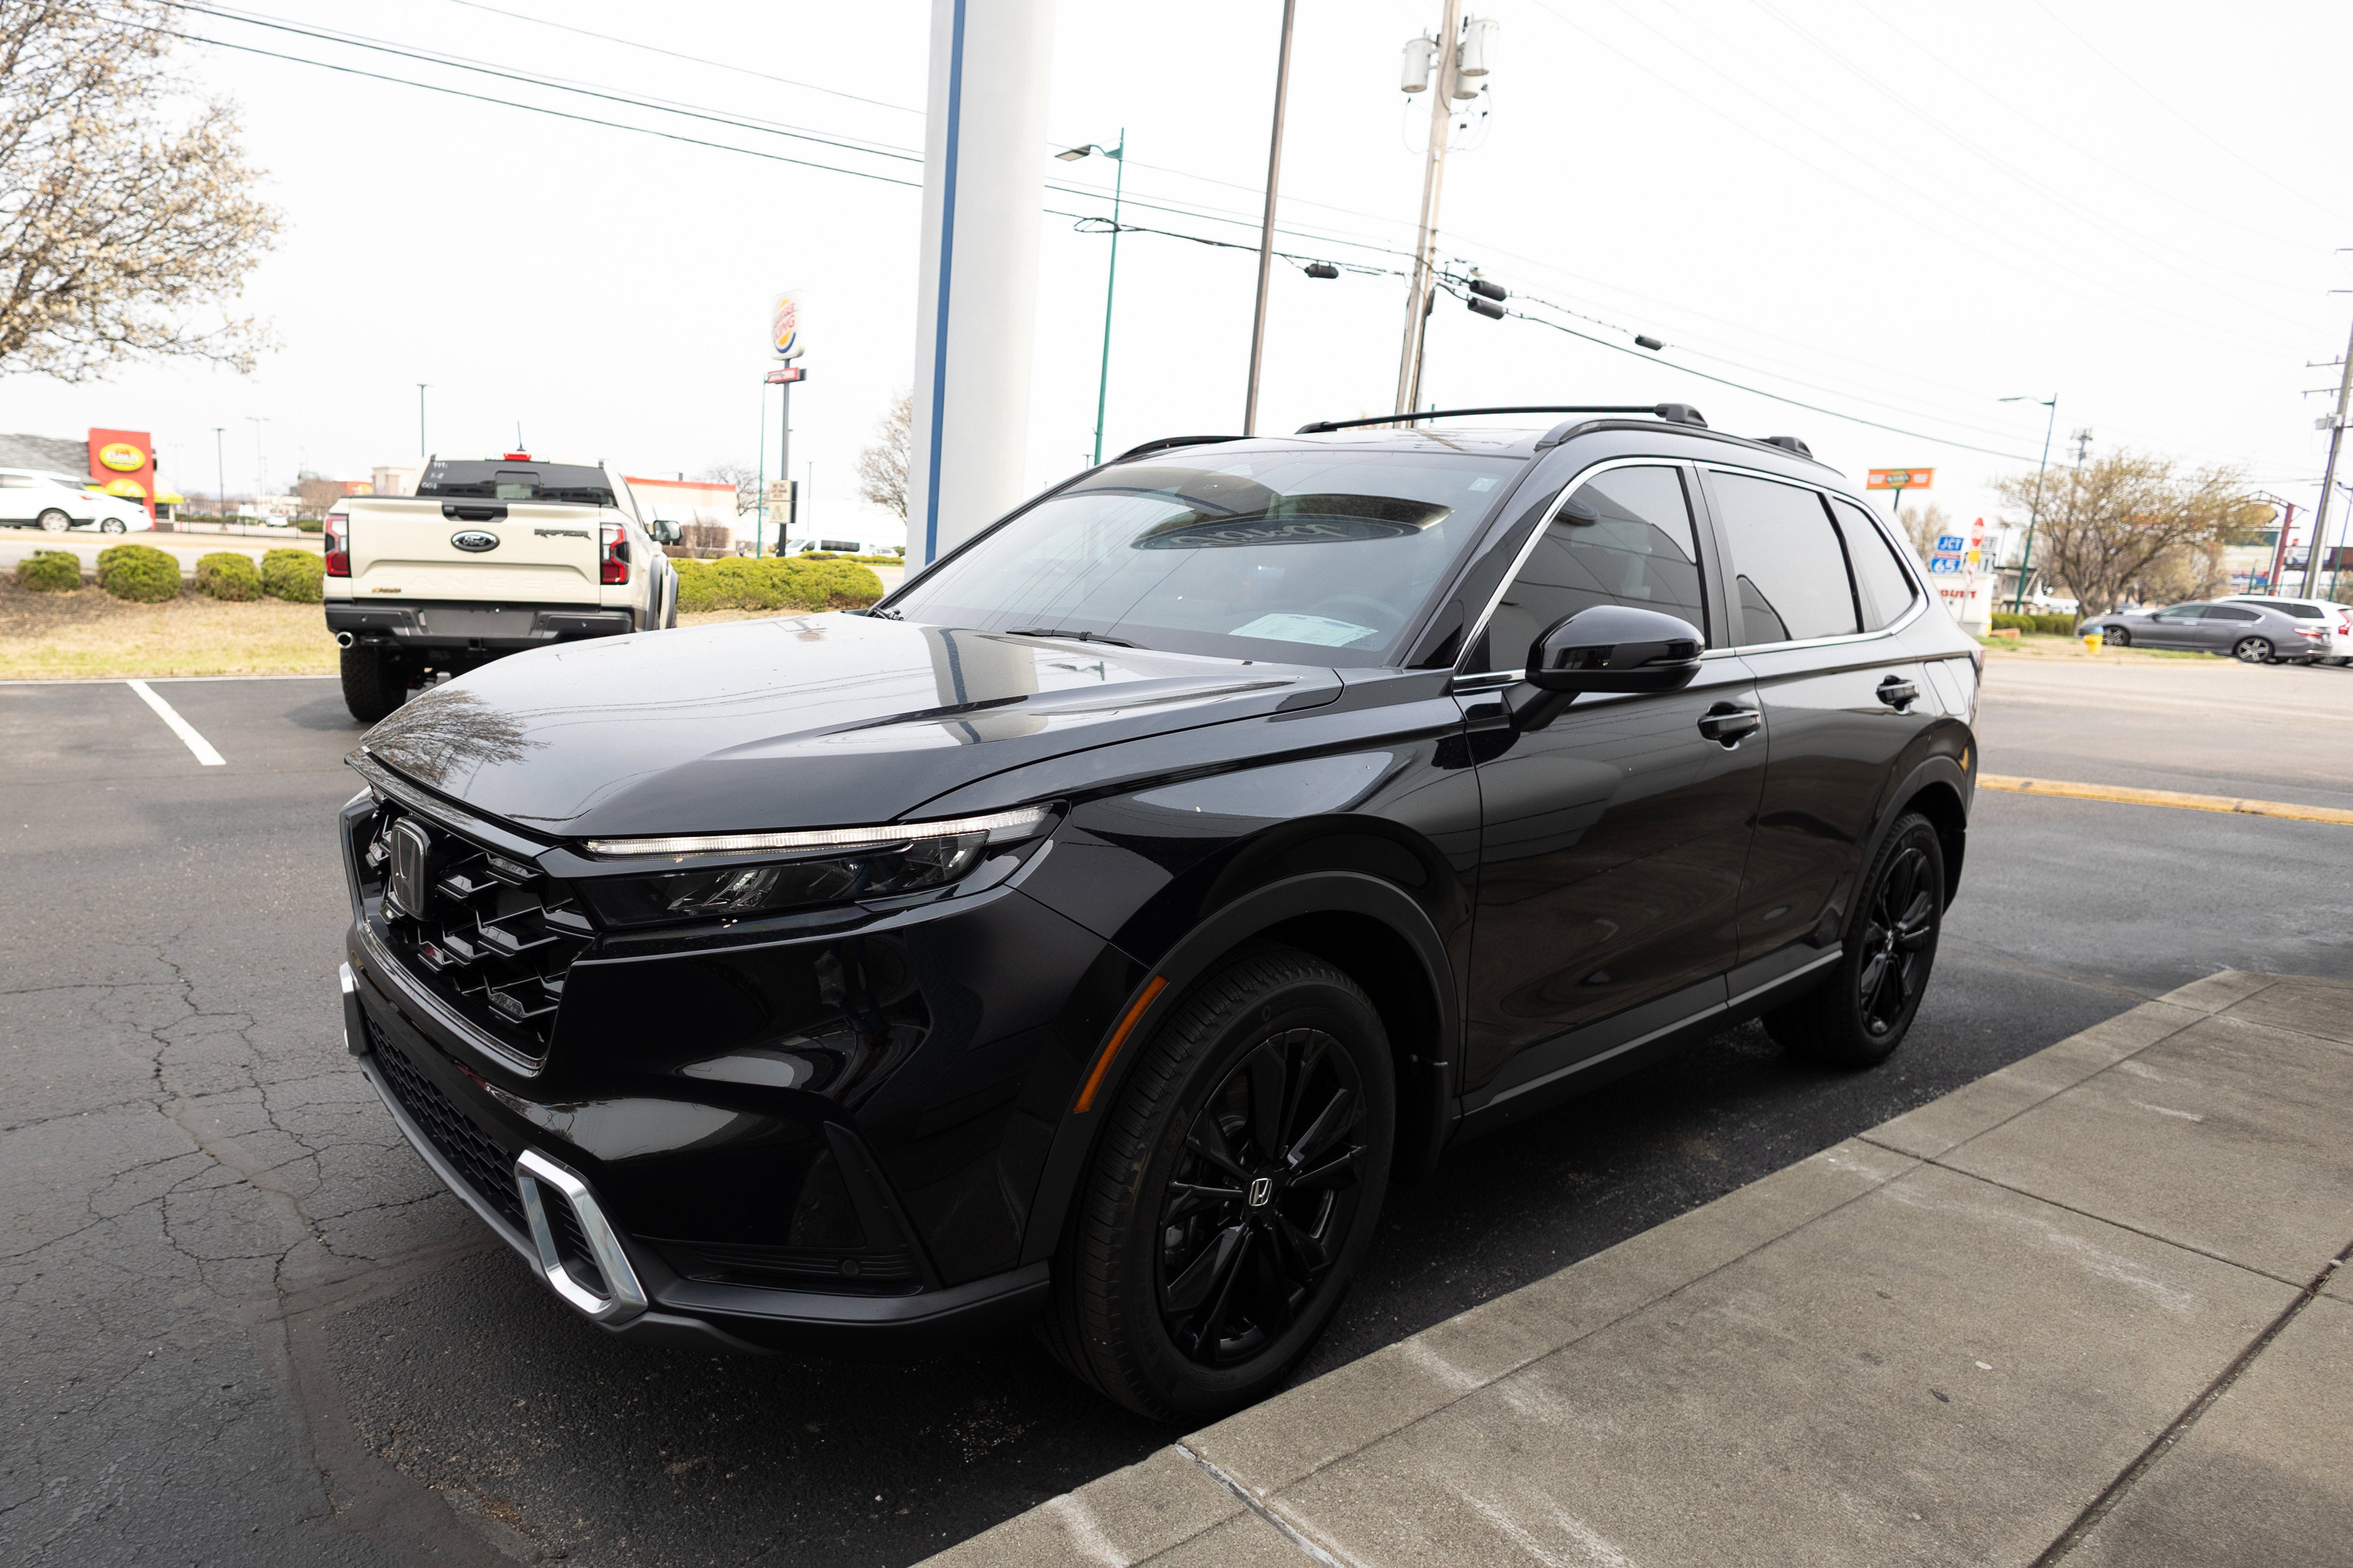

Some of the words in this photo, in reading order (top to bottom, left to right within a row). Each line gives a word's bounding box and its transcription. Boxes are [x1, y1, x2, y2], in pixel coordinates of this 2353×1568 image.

[535, 529, 592, 540] RAPTOR
[462, 535, 486, 546] Ford
[1941, 538, 1962, 549] JCT
[1935, 560, 1956, 572] 65
[378, 575, 576, 591] RANGER
